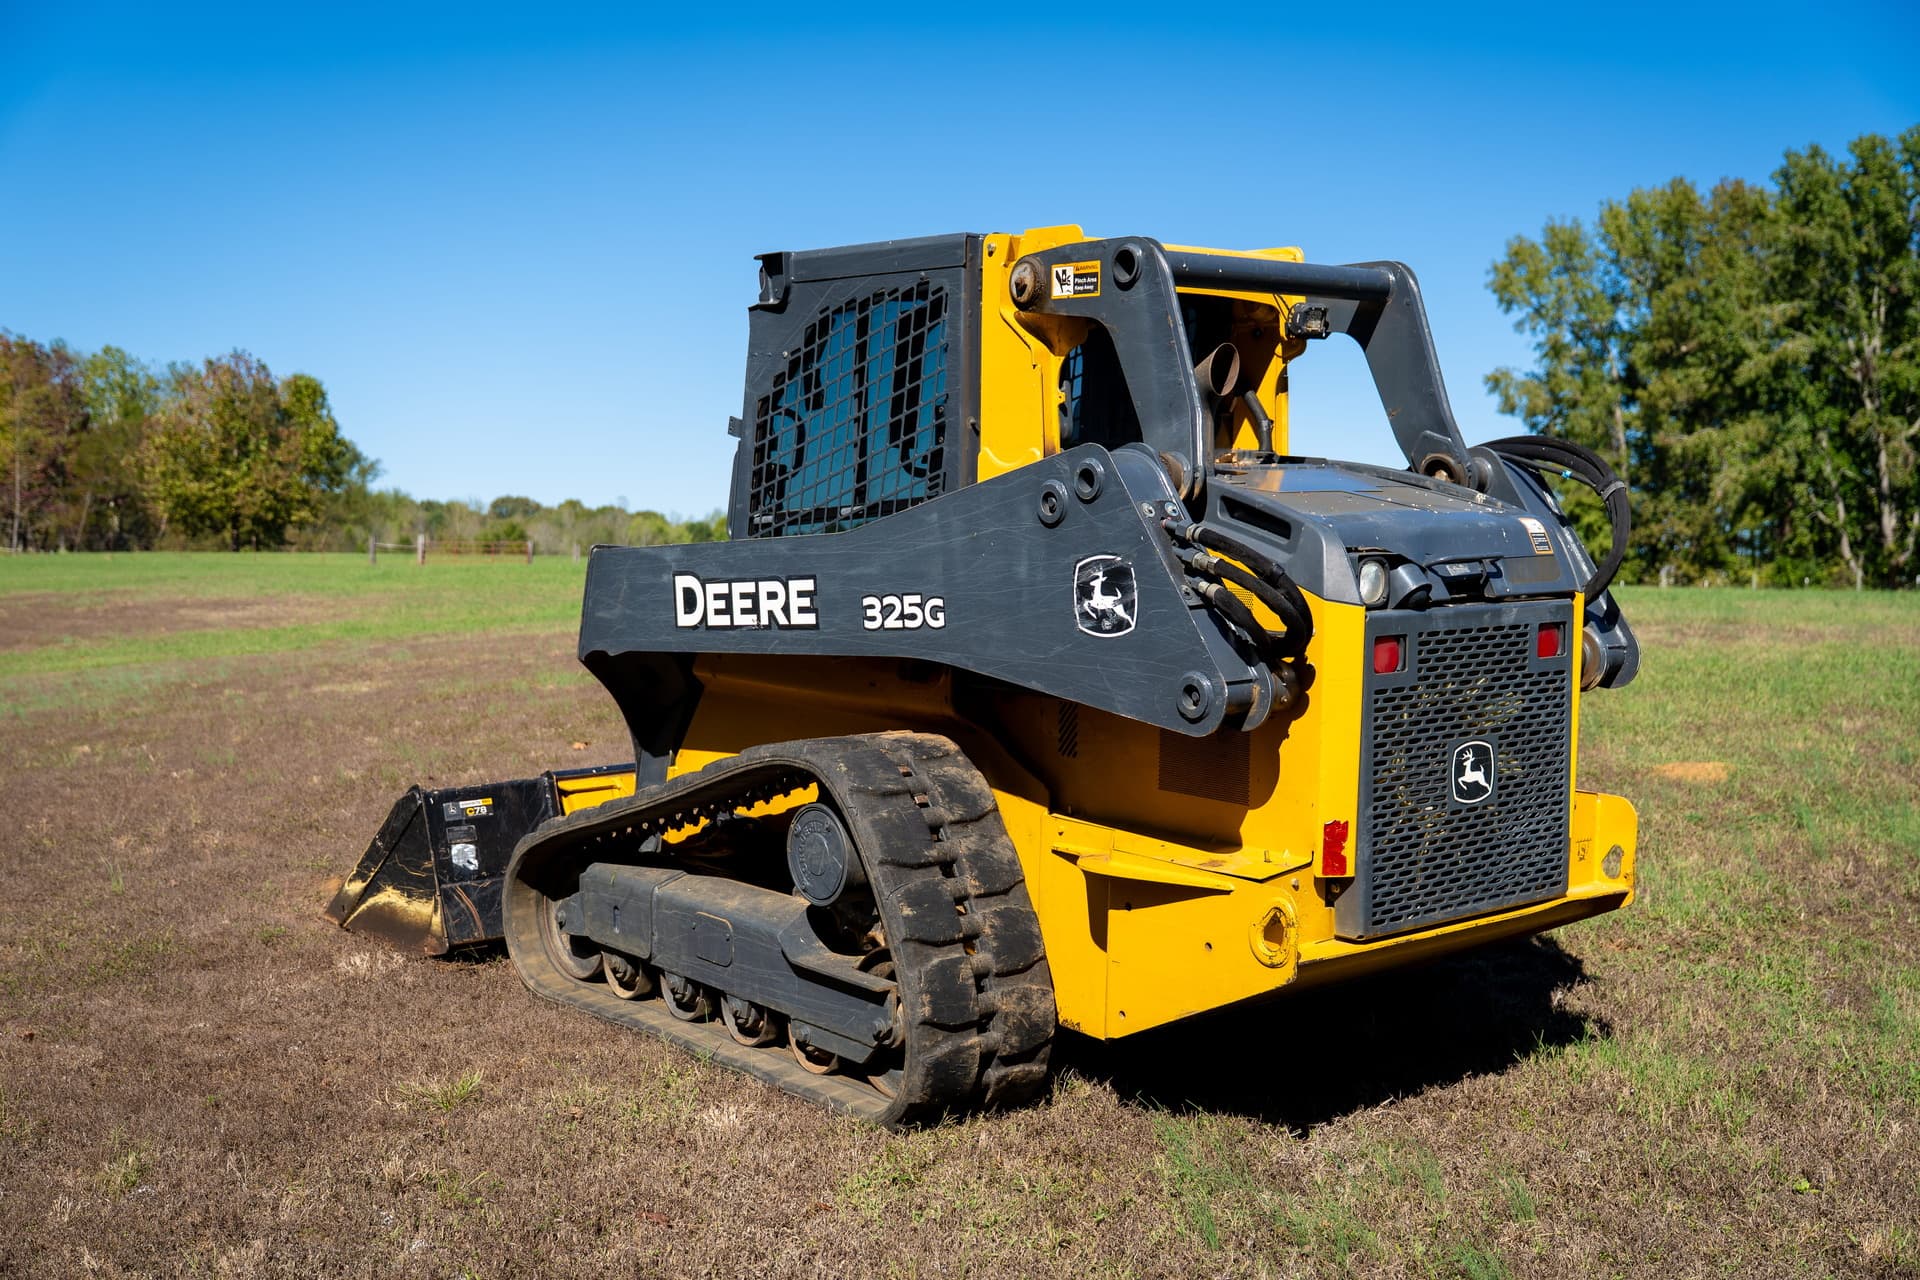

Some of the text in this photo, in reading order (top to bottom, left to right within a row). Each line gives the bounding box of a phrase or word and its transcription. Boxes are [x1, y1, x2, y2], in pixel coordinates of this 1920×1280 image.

[674, 575, 817, 627] DEERE
[862, 595, 945, 629] 325G
[466, 806, 487, 816] C78
